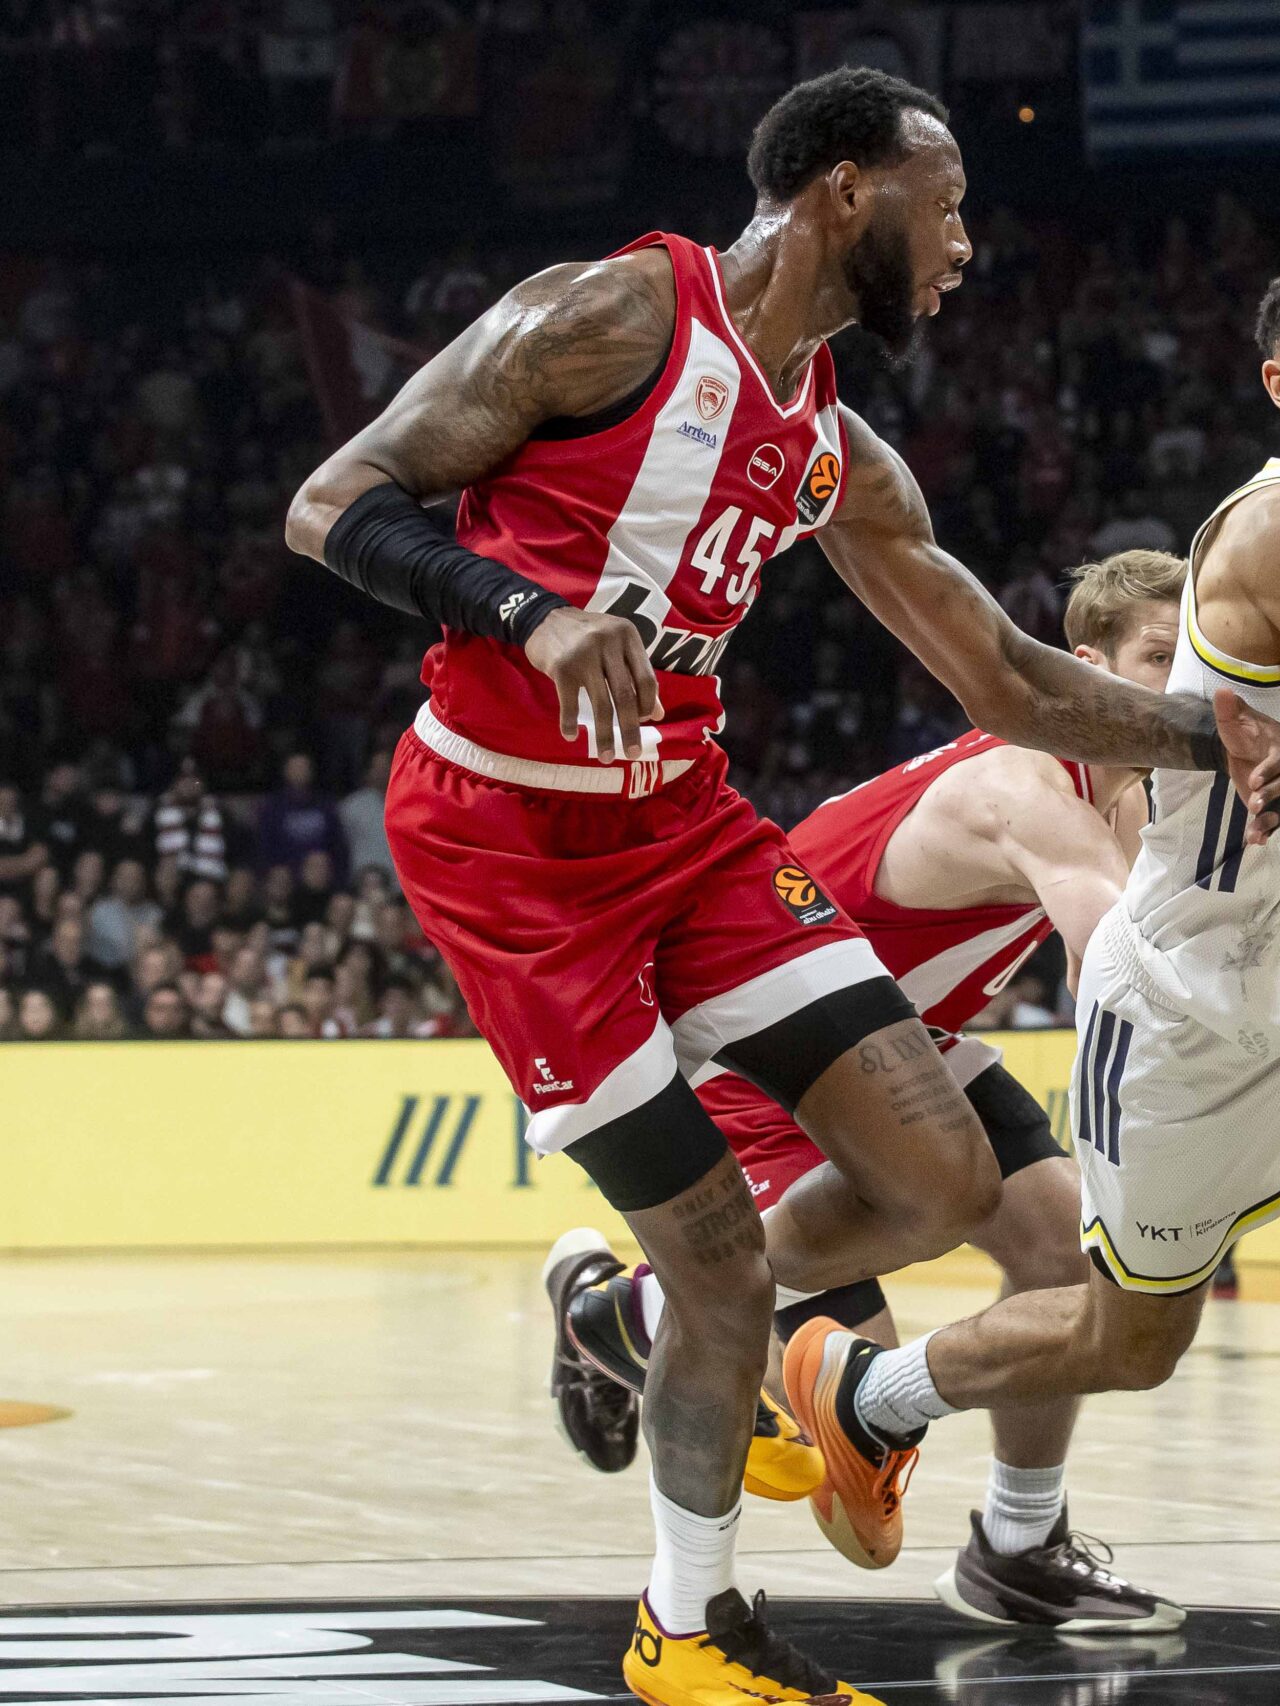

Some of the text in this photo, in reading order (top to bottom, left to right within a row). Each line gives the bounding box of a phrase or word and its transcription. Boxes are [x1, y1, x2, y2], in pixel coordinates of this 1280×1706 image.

[752, 457, 777, 477] GSA
[690, 505, 776, 605] 45
[532, 1080, 574, 1095] FlexCar
[1136, 1221, 1184, 1242] YKT
